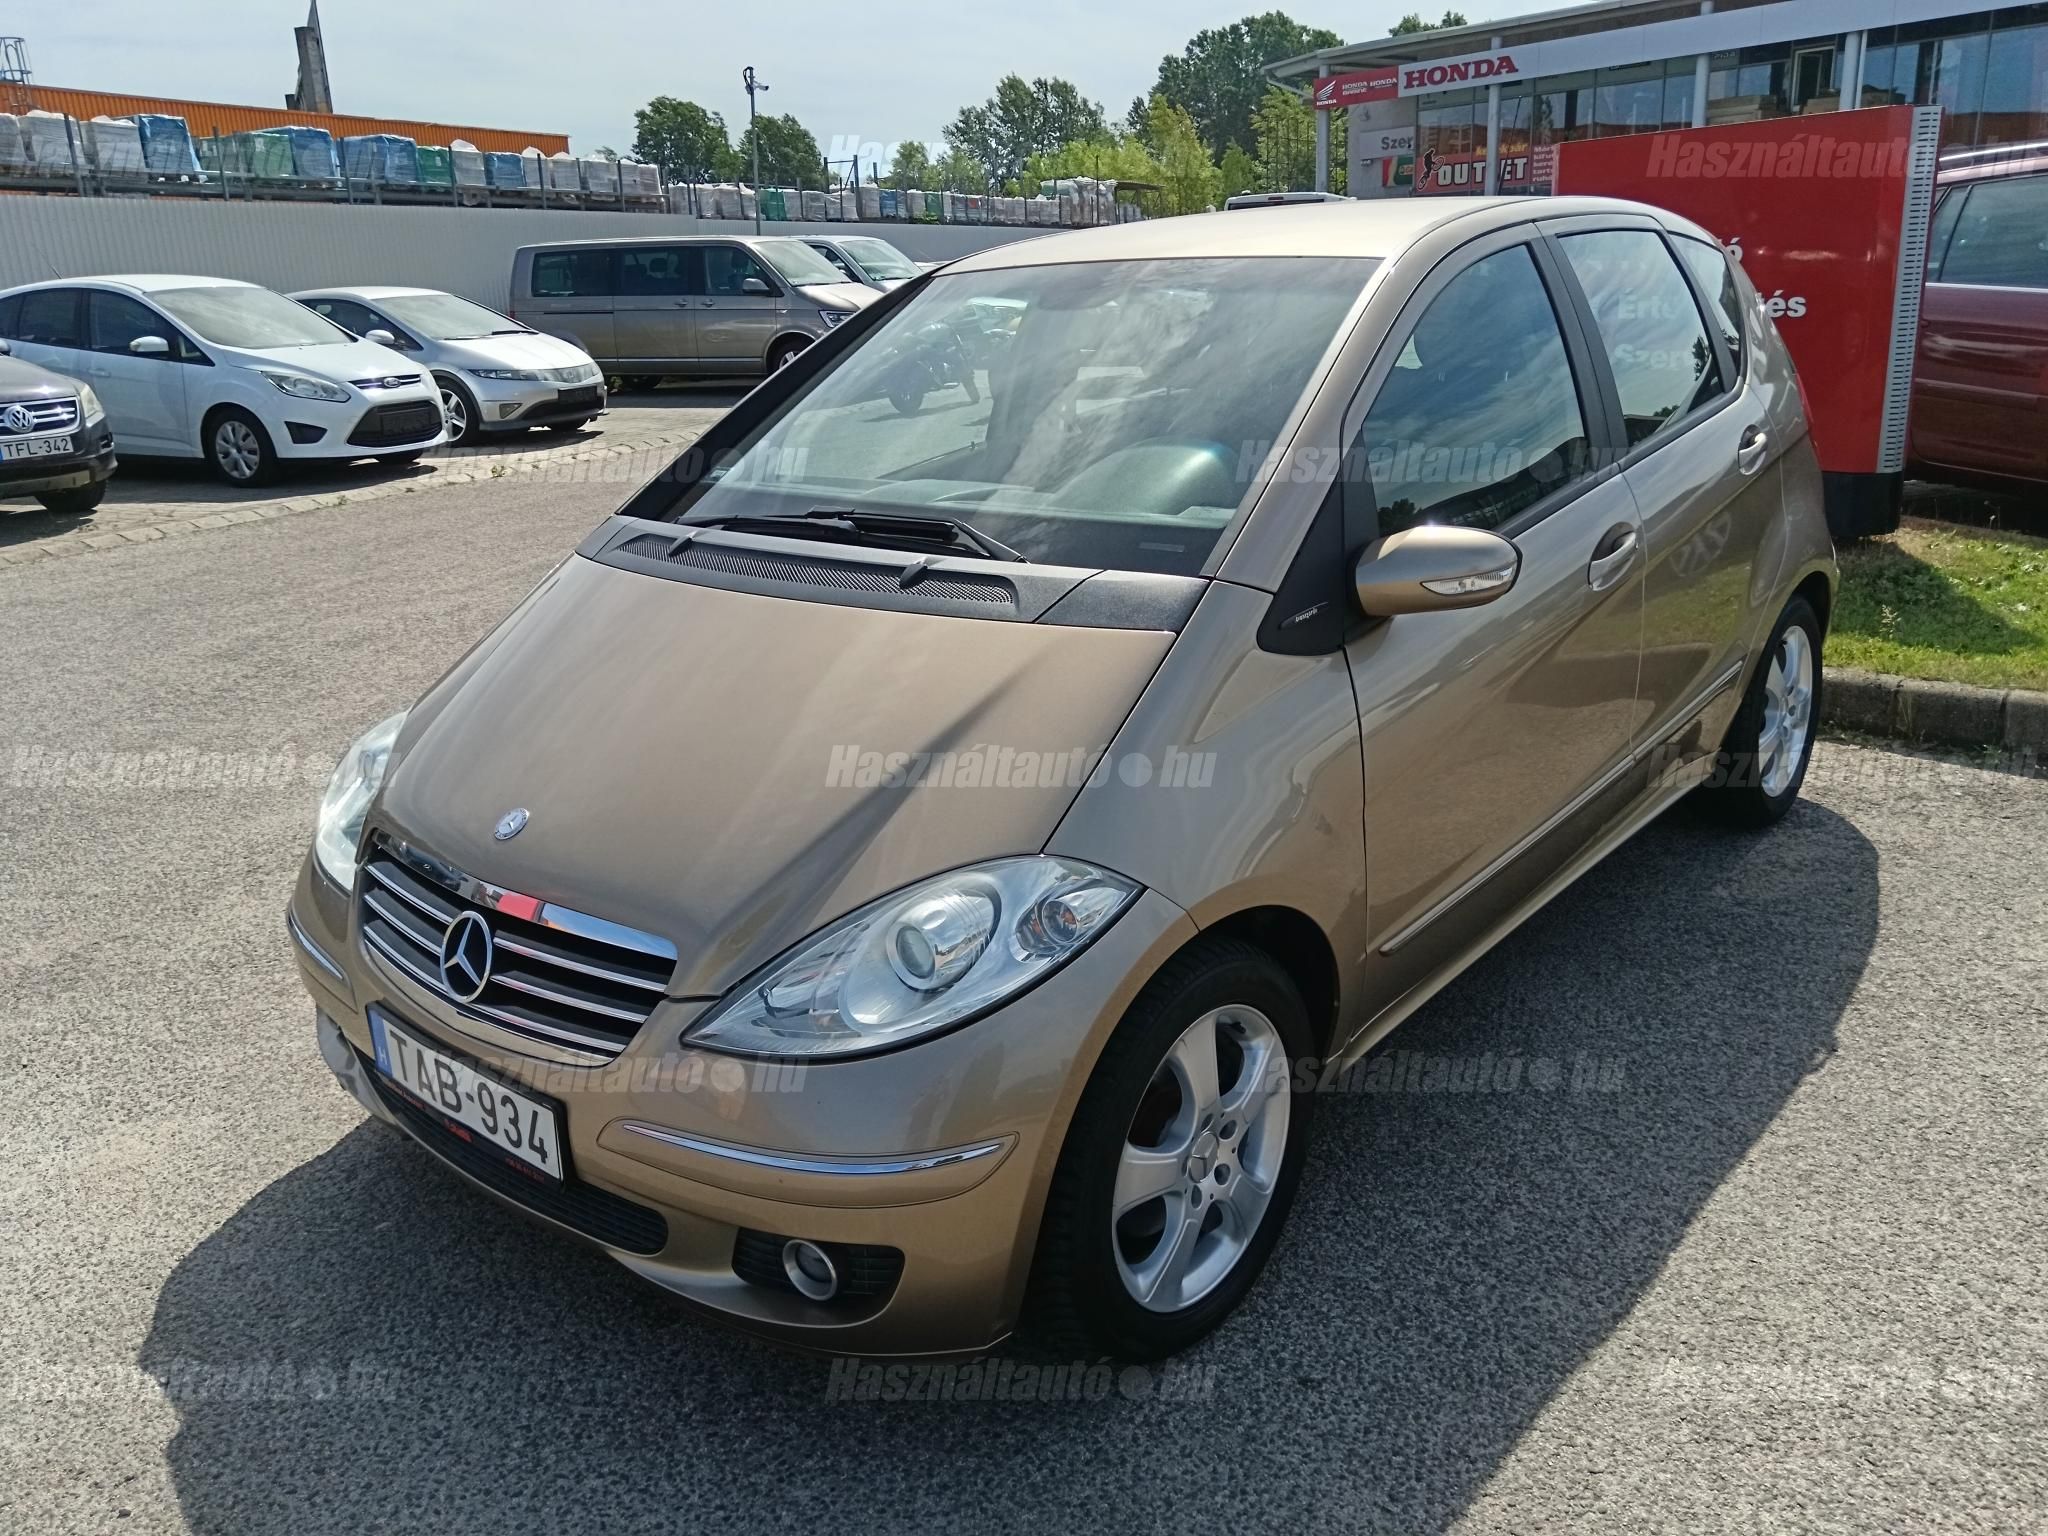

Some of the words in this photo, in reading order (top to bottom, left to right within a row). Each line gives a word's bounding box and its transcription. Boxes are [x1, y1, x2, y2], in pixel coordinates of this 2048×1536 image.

[1404, 55, 1519, 90] HONDA
[1437, 157, 1528, 186] OUTET
[4, 438, 70, 457] TFL-342
[390, 1029, 548, 1165] TAB-934
